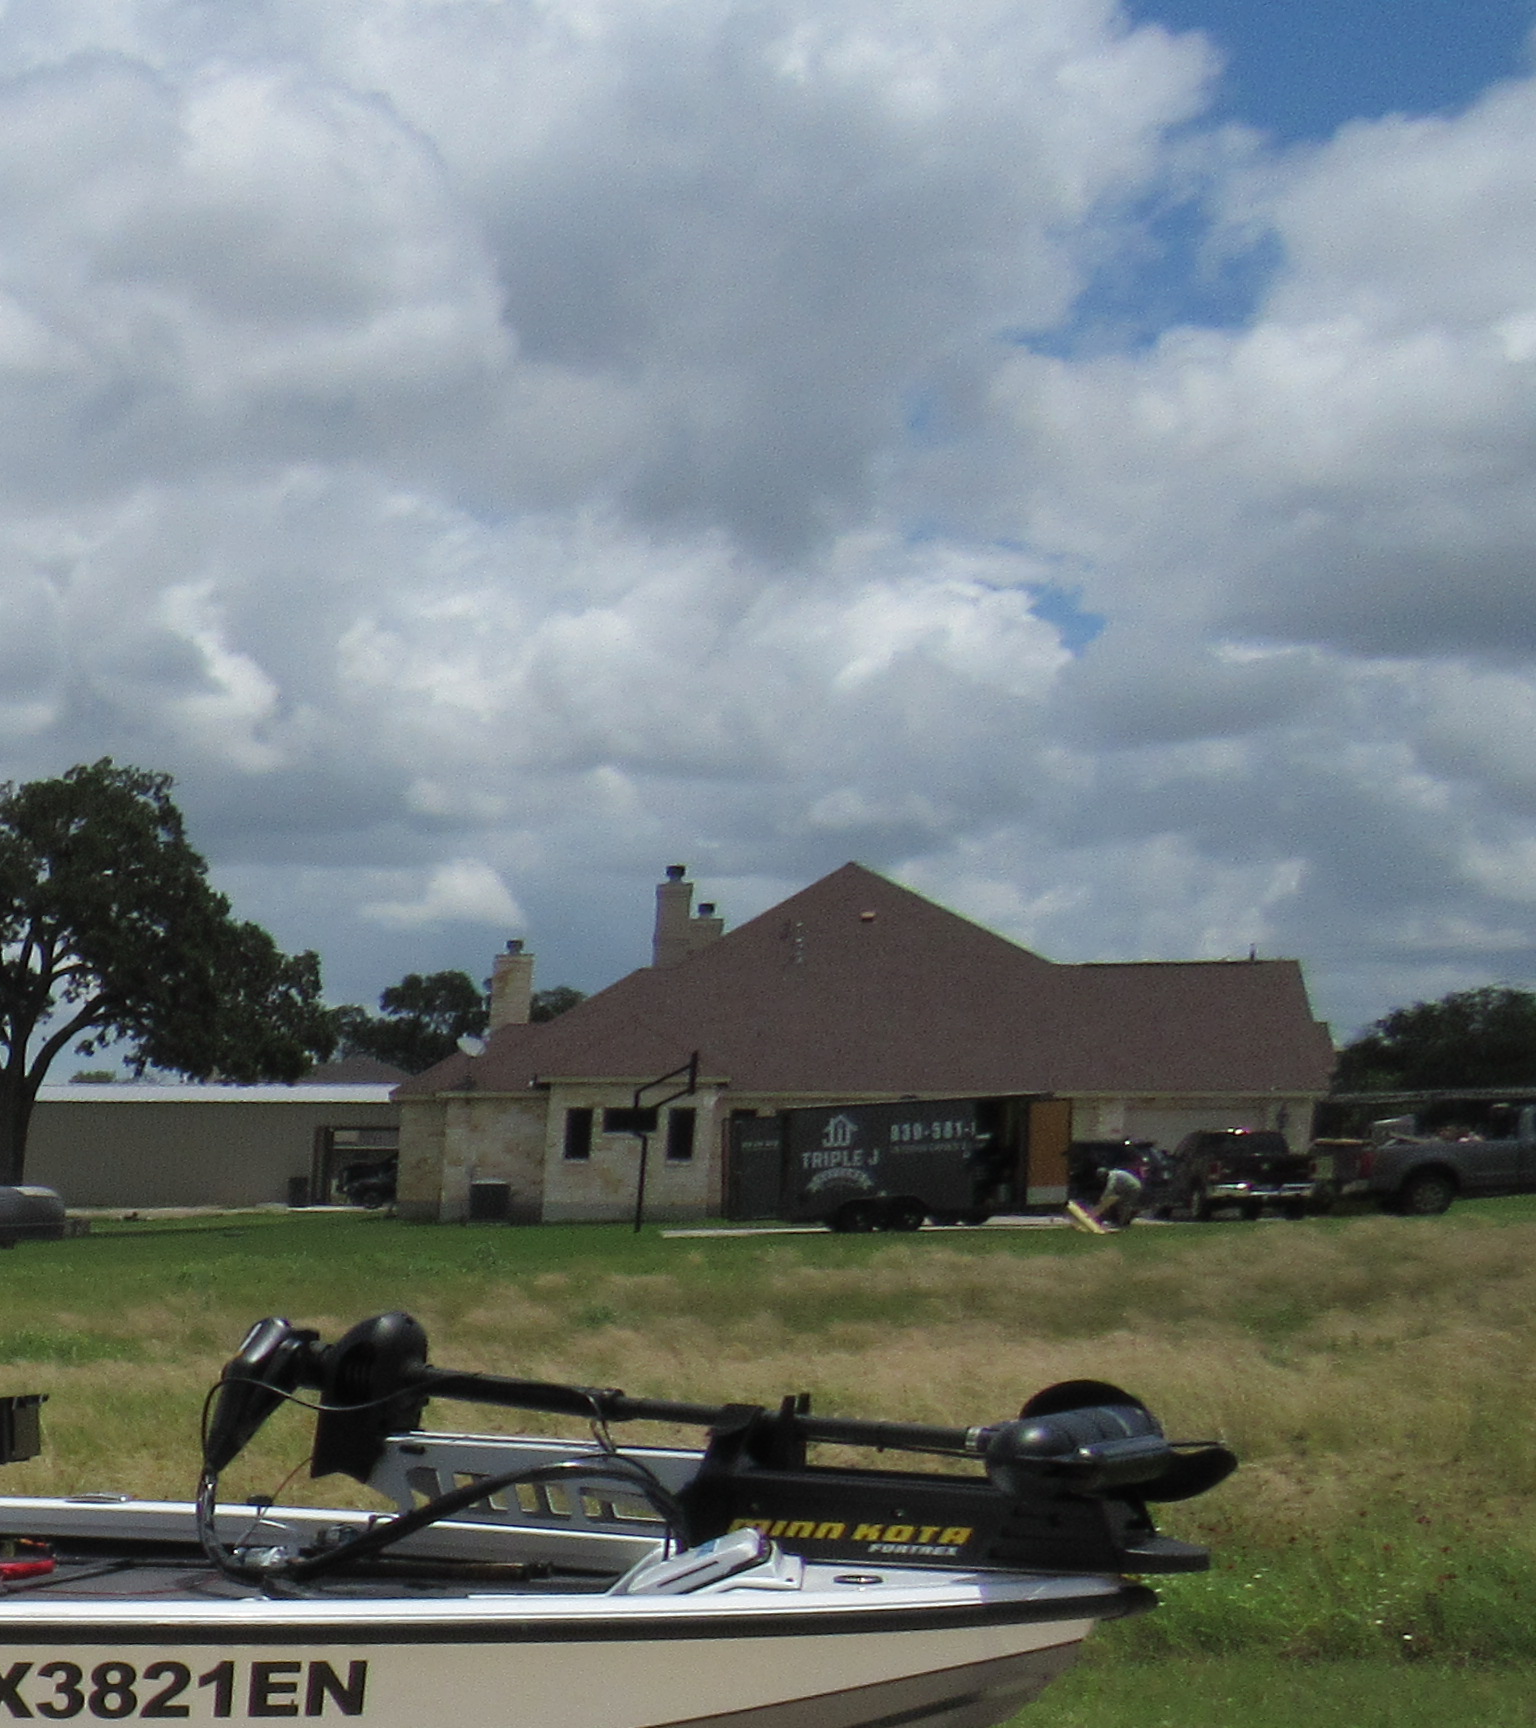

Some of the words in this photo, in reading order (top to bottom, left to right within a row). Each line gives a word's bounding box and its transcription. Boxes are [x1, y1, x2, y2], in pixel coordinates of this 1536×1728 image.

[802, 1151, 863, 1168] TRIPLE
[868, 1149, 879, 1165] J
[851, 1524, 974, 1545] KOTA
